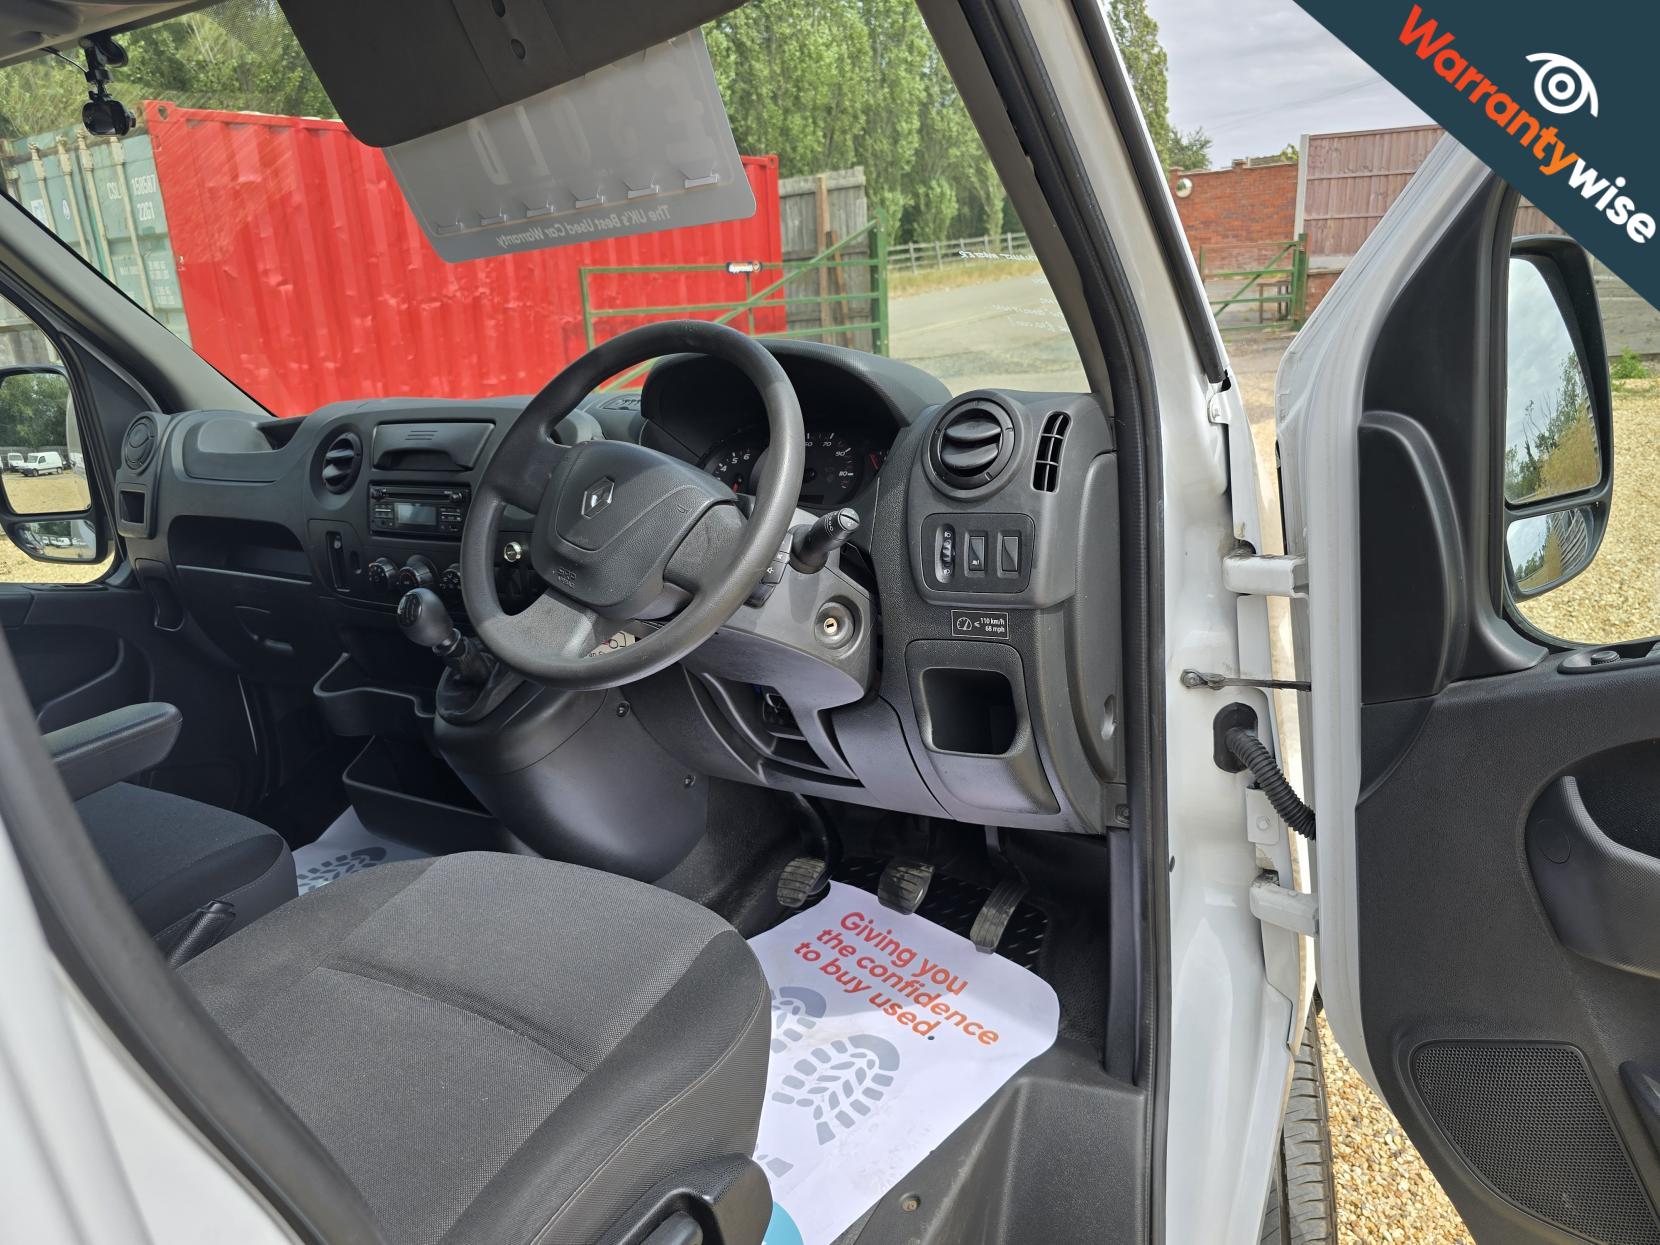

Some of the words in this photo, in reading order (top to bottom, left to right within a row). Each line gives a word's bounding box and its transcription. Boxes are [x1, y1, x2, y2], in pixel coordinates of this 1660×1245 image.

[990, 617, 1005, 625] km/h
[992, 626, 1005, 634] mph
[794, 942, 821, 962] to
[819, 957, 873, 994] buy
[868, 992, 942, 1041] used.
[816, 928, 857, 958] the
[856, 956, 999, 1045] confidence
[840, 911, 918, 968] Giving
[912, 957, 968, 996] you
